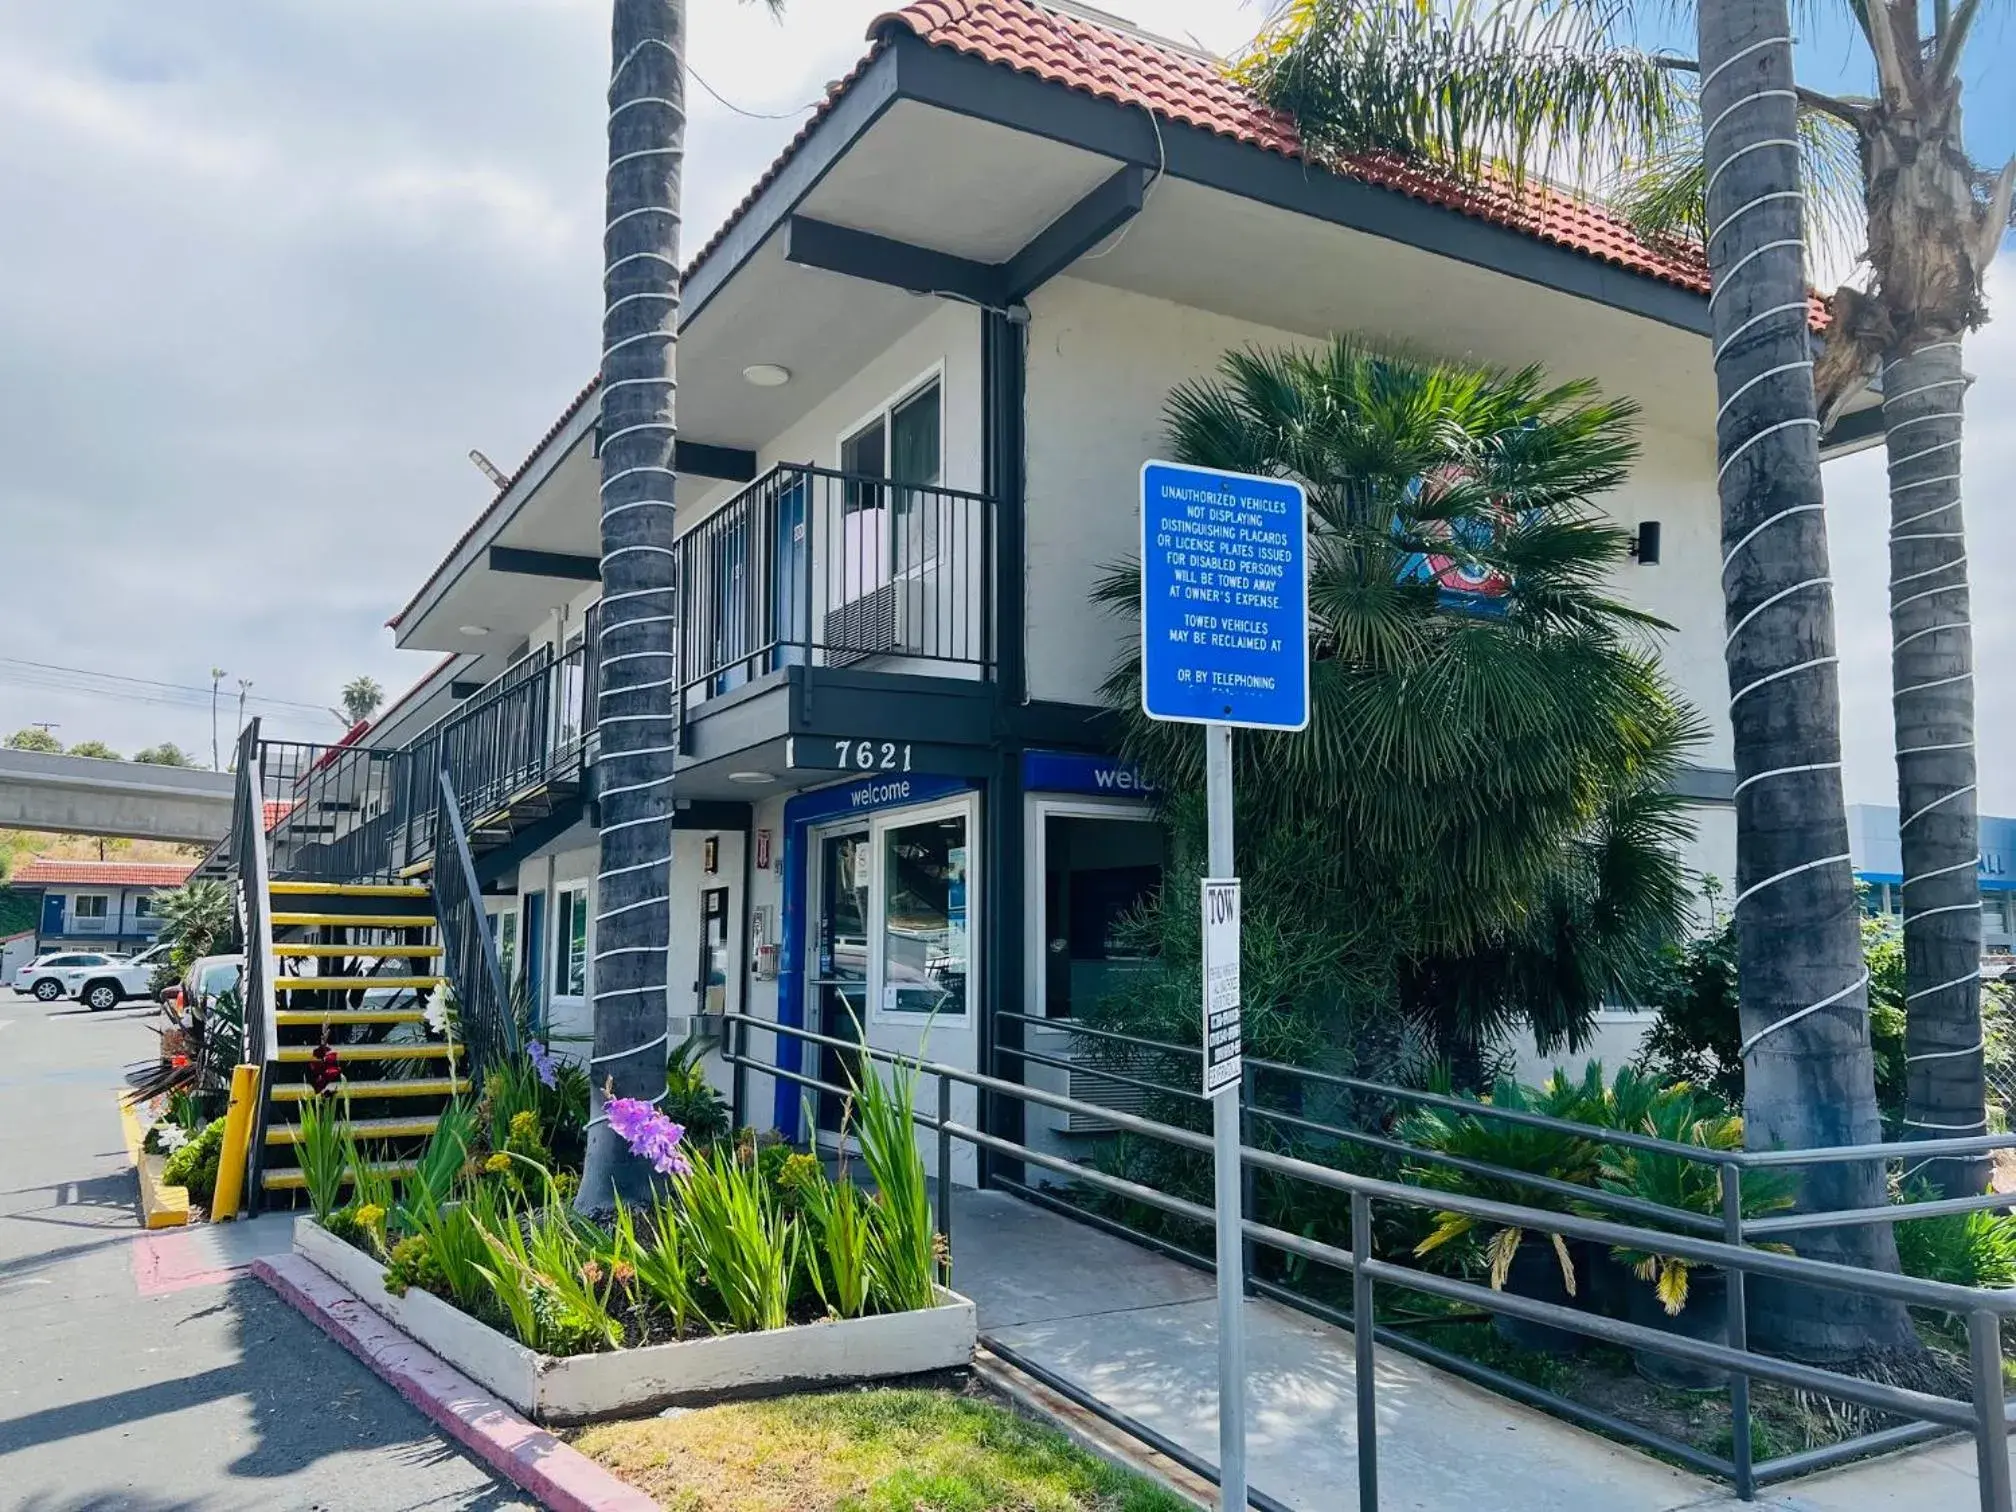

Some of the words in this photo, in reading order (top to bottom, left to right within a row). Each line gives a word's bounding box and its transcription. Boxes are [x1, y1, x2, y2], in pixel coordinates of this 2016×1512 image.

[1162, 487, 1235, 508] UNAUTHORIZED
[1241, 498, 1285, 514] VEHICLES
[1188, 507, 1204, 518] NOT
[1209, 509, 1262, 526] DISPLAYING
[1161, 518, 1235, 539] DISTINGUISHING
[1240, 529, 1287, 546] PLACARDS
[1158, 534, 1170, 545] OR
[1176, 538, 1214, 552] LICENSE
[1220, 543, 1253, 557] PLATES
[1259, 548, 1291, 561] ISSUED
[1168, 552, 1185, 564] FOR
[1190, 555, 1235, 571] DISABLED
[1240, 561, 1282, 576] PERSONS
[1175, 570, 1196, 582] WILL
[1201, 573, 1212, 584] BE
[1219, 575, 1249, 589] TOWED
[1254, 580, 1275, 591] AWAY
[1170, 586, 1180, 596] AT
[1186, 587, 1230, 603] OWNER'S
[1186, 615, 1216, 628] TOWED
[1222, 619, 1267, 635] VEHICLES
[1170, 630, 1188, 641] MAY
[1194, 632, 1206, 644] BE
[1212, 632, 1266, 650] RECLAIMED
[1271, 640, 1280, 650] AT
[1178, 669, 1190, 681] OR
[1196, 671, 1207, 682] BY
[1213, 672, 1274, 690] TELEPHONING
[836, 741, 911, 772] 7621
[851, 780, 910, 807] welcome
[1208, 889, 1234, 924] TOW
